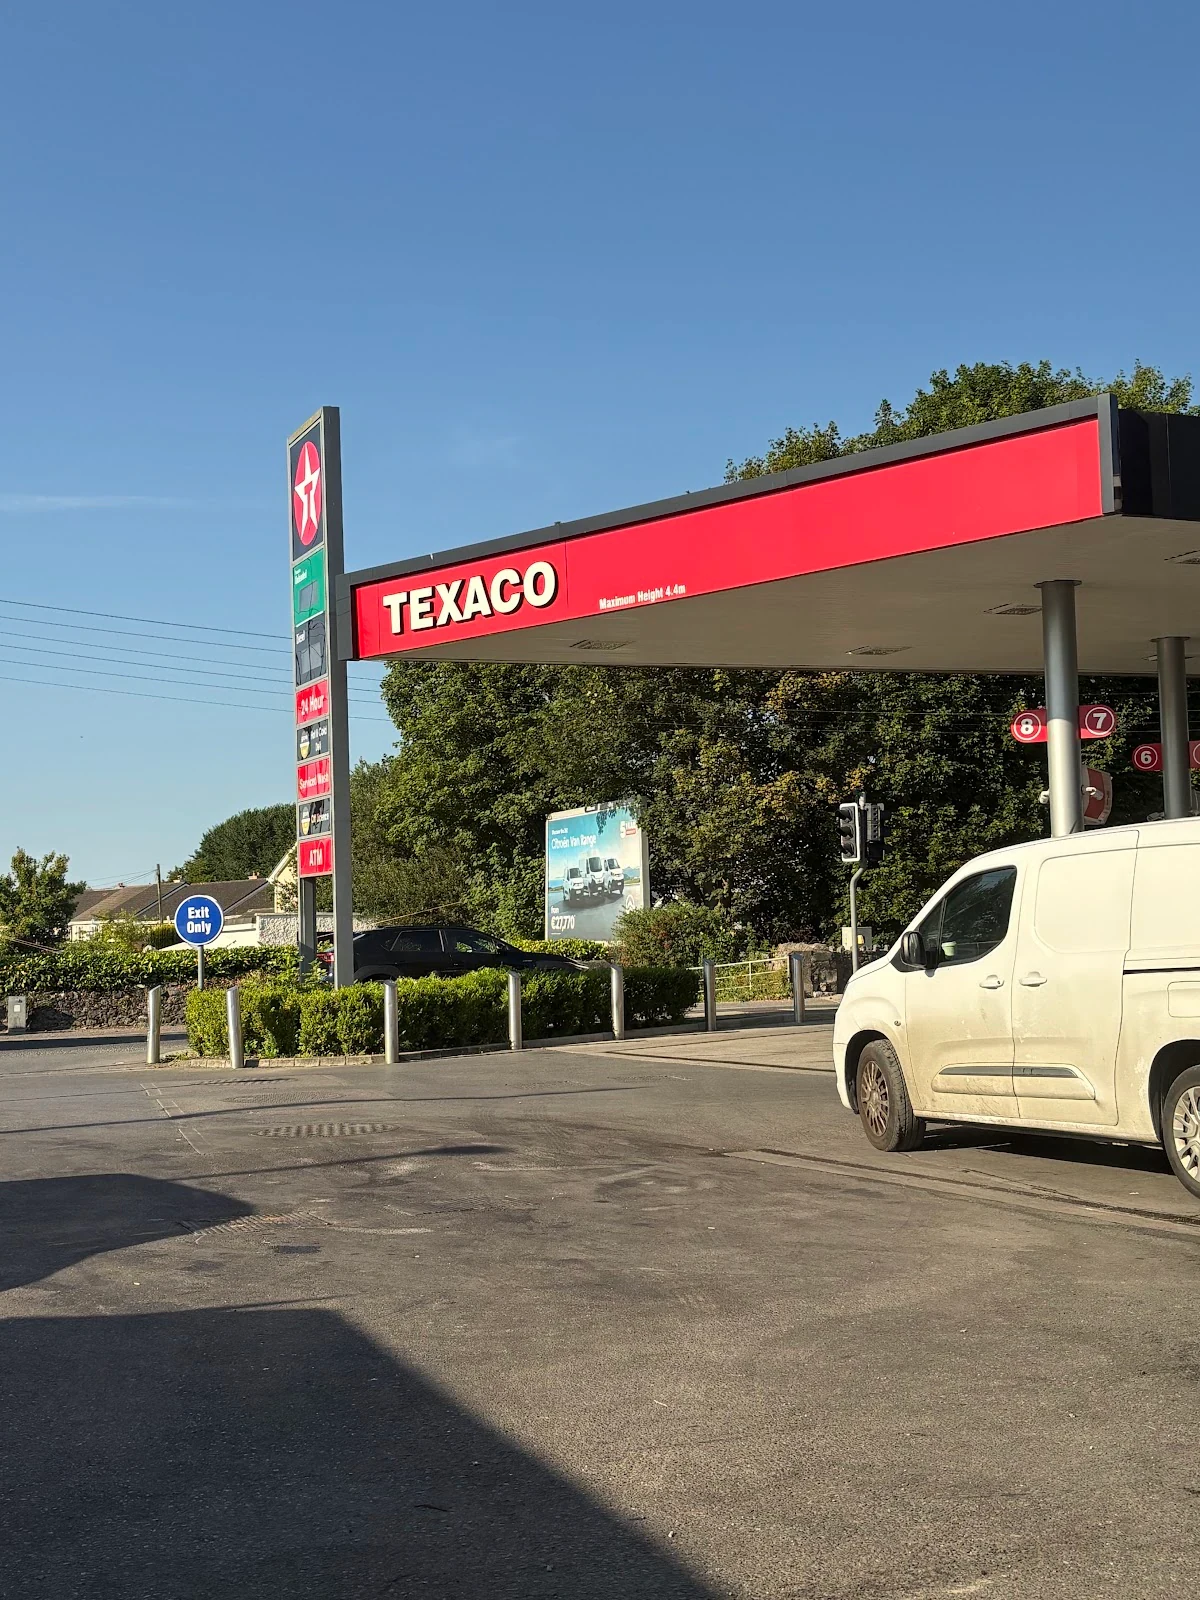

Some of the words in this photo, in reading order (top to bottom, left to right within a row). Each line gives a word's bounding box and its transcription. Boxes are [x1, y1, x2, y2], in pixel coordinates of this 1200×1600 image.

[383, 561, 558, 635] TEXACO
[599, 594, 635, 610] Maximum
[637, 587, 663, 603] Height
[665, 584, 686, 597] 4.4m
[301, 697, 309, 716] 24
[310, 694, 324, 713] Hour
[1020, 718, 1034, 735] 8
[1092, 712, 1107, 729] 7
[1140, 750, 1152, 764] 6
[570, 836, 580, 847] Van
[580, 834, 597, 848] Range
[309, 848, 323, 867] ATM
[188, 906, 209, 919] Exit
[187, 920, 211, 935] Only
